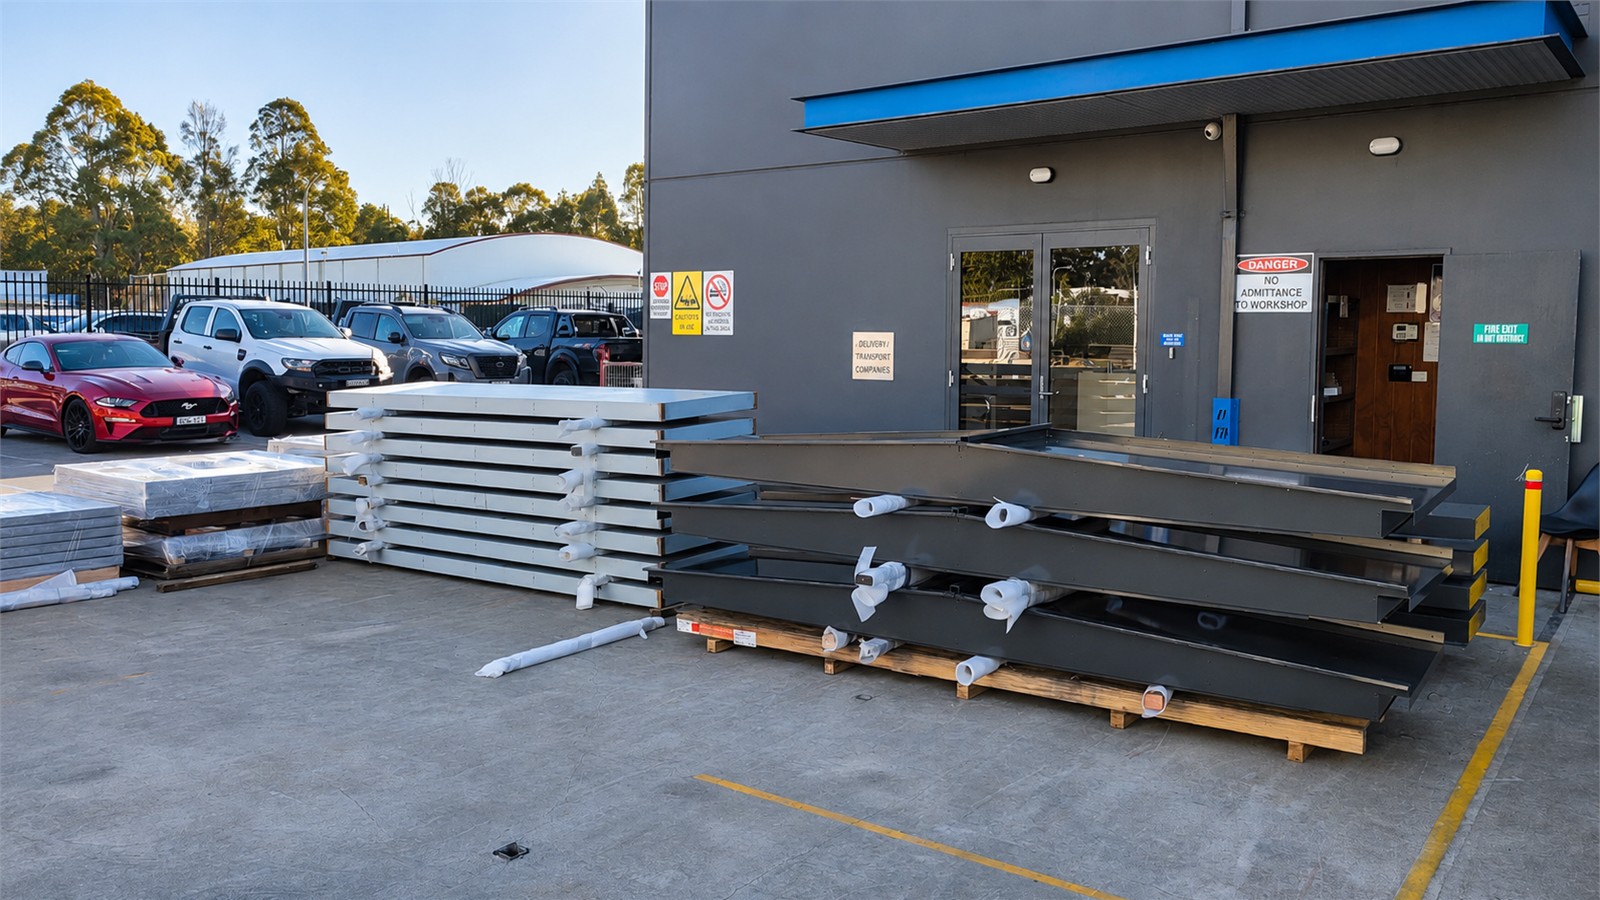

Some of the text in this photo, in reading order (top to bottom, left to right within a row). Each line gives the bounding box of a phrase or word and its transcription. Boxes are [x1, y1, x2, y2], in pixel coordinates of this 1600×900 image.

[1248, 260, 1298, 270] DANGER
[1264, 276, 1279, 285] NO
[654, 281, 668, 291] STOP
[1241, 288, 1302, 297] ADMITTANCE
[1236, 300, 1308, 310] TO WORKSHOP
[855, 366, 891, 374] COMPANIES
